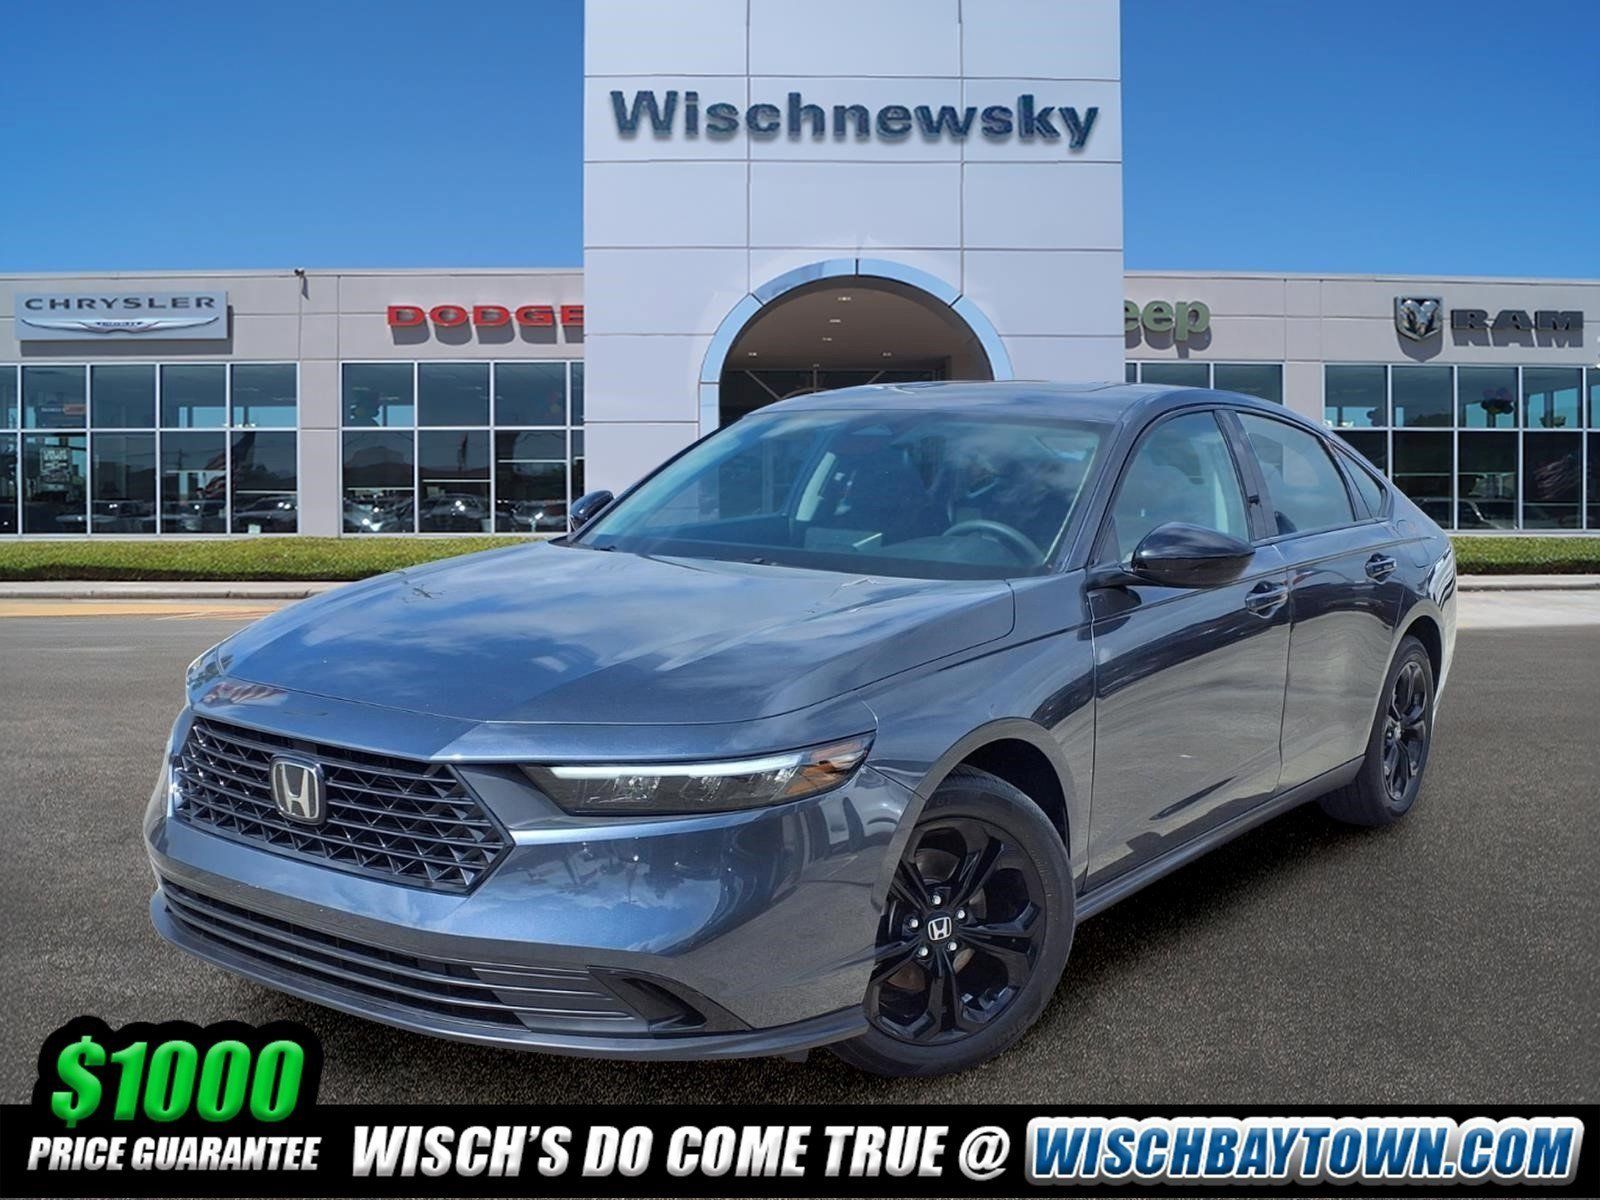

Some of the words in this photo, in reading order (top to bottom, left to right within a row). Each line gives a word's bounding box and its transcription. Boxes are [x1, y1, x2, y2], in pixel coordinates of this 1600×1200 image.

[609, 90, 1099, 149] Wischnewsky
[24, 296, 216, 311] CHRYSLER
[387, 305, 584, 327] DODGE
[1450, 308, 1584, 330] RAM
